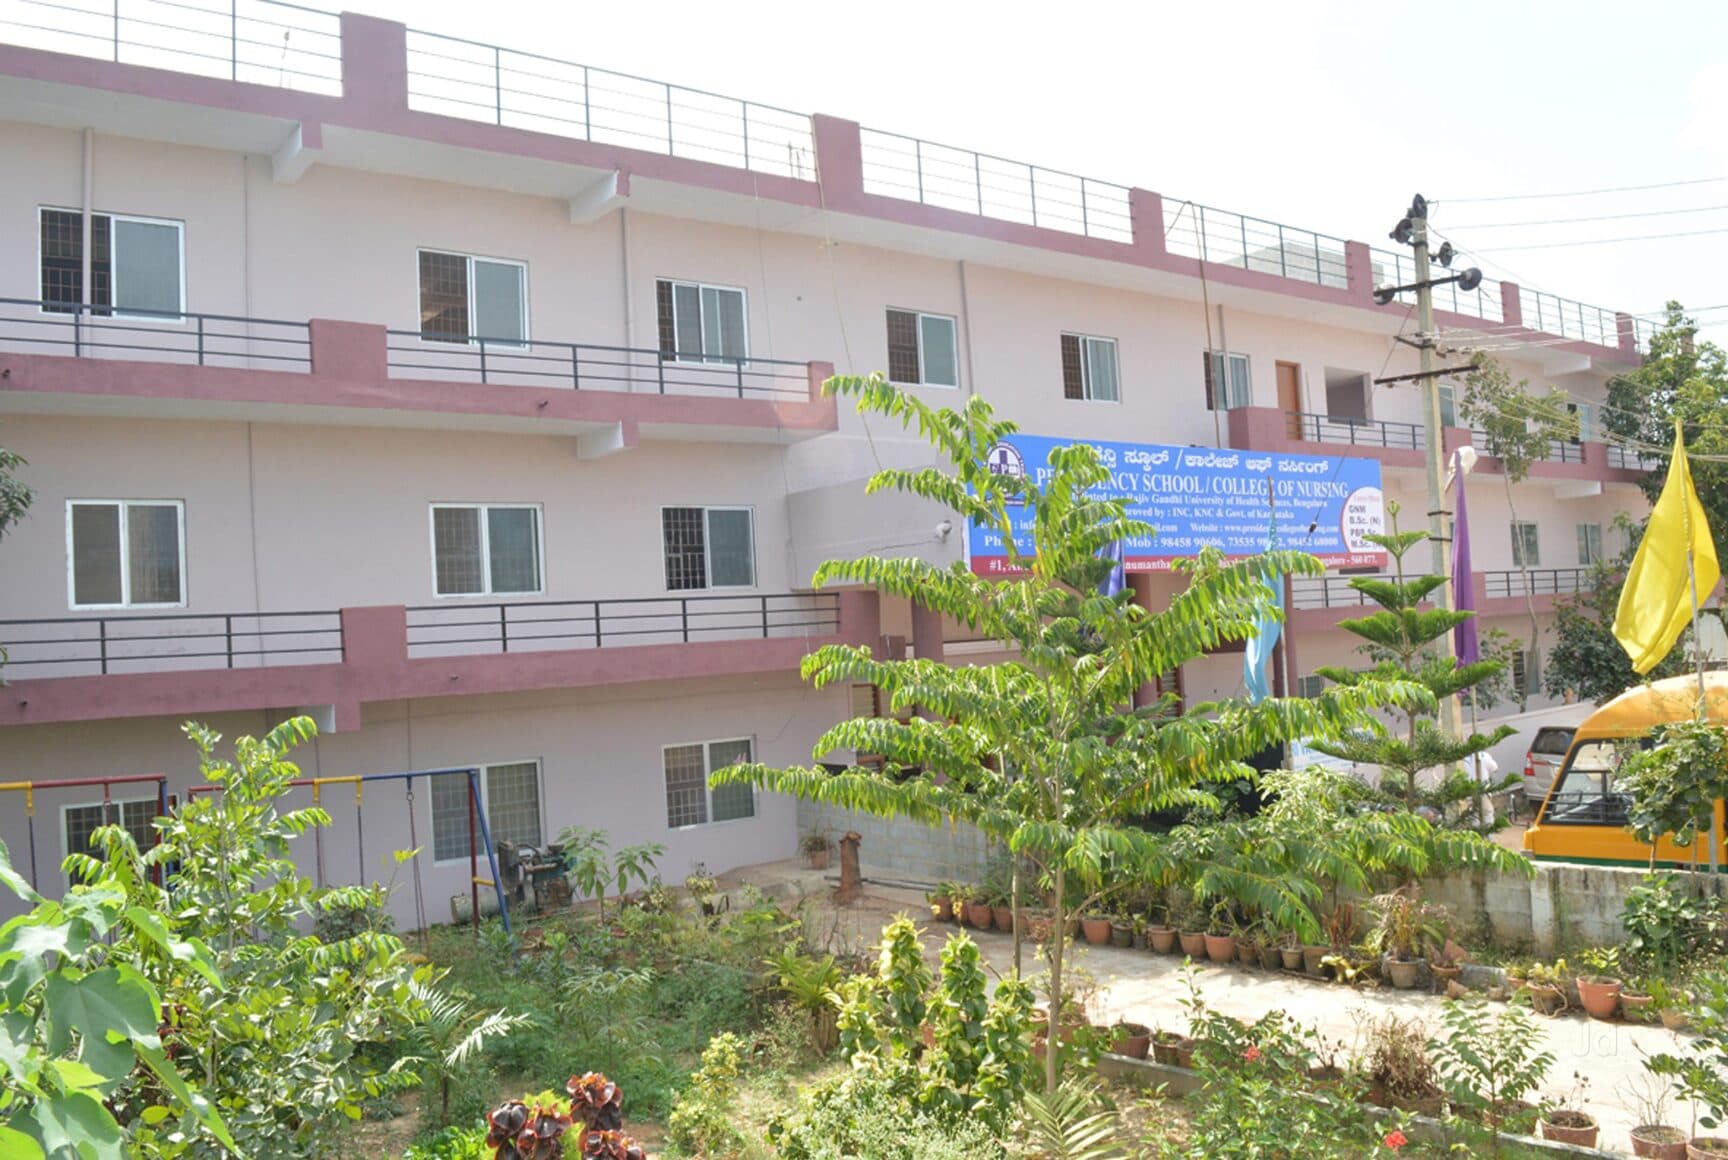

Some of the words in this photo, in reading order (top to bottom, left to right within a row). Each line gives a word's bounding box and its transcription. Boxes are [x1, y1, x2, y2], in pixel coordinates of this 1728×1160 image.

[1142, 473, 1203, 494] SCHOOL
[1278, 479, 1294, 496] OF
[1296, 481, 1349, 499] NURSING
[1152, 493, 1182, 504] Gandhi
[1184, 494, 1224, 506] University
[1226, 496, 1235, 506] of
[1236, 496, 1260, 506] Health
[1154, 507, 1164, 519] by
[1257, 510, 1295, 519] Karataka
[1348, 505, 1366, 513] GNM
[984, 535, 1024, 547] Phne
[1125, 537, 1151, 548] Mob
[1160, 536, 1192, 548] 98458
